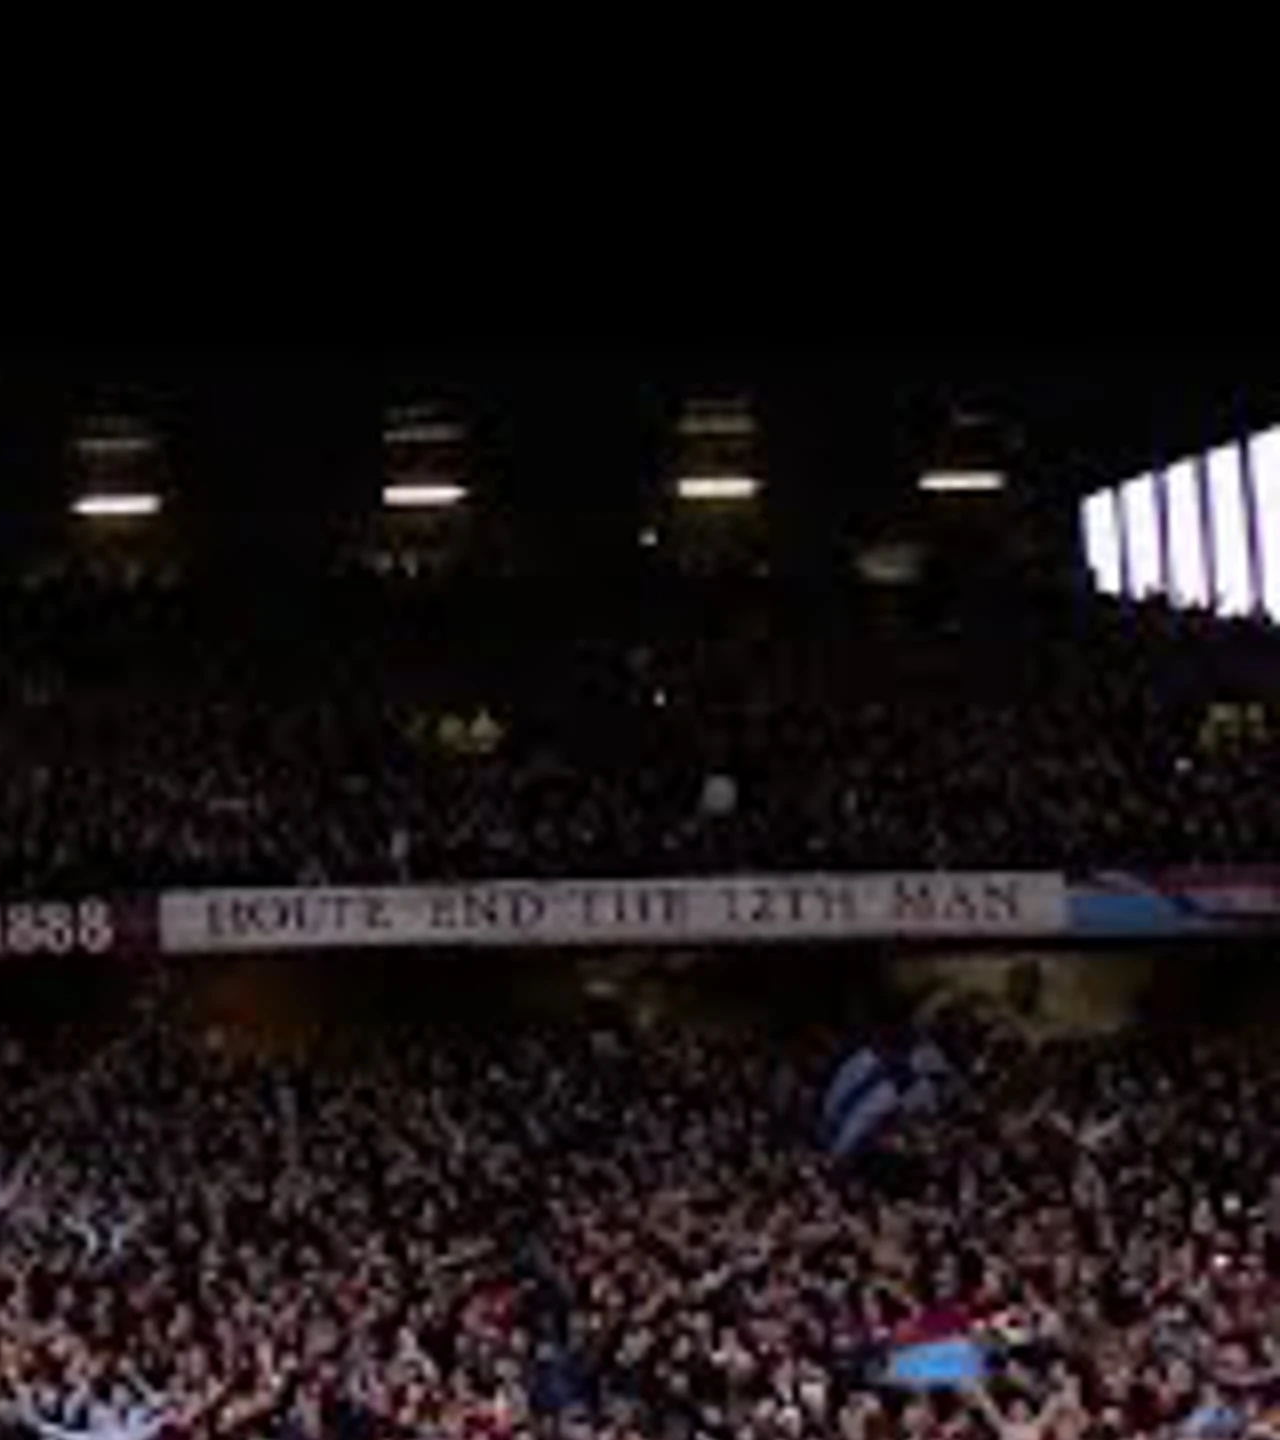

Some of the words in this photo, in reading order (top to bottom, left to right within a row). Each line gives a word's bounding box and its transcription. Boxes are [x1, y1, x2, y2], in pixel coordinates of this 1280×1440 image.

[429, 887, 545, 931] END
[574, 884, 687, 926] THE
[724, 882, 852, 924] 12TH
[892, 876, 1020, 921] MAN
